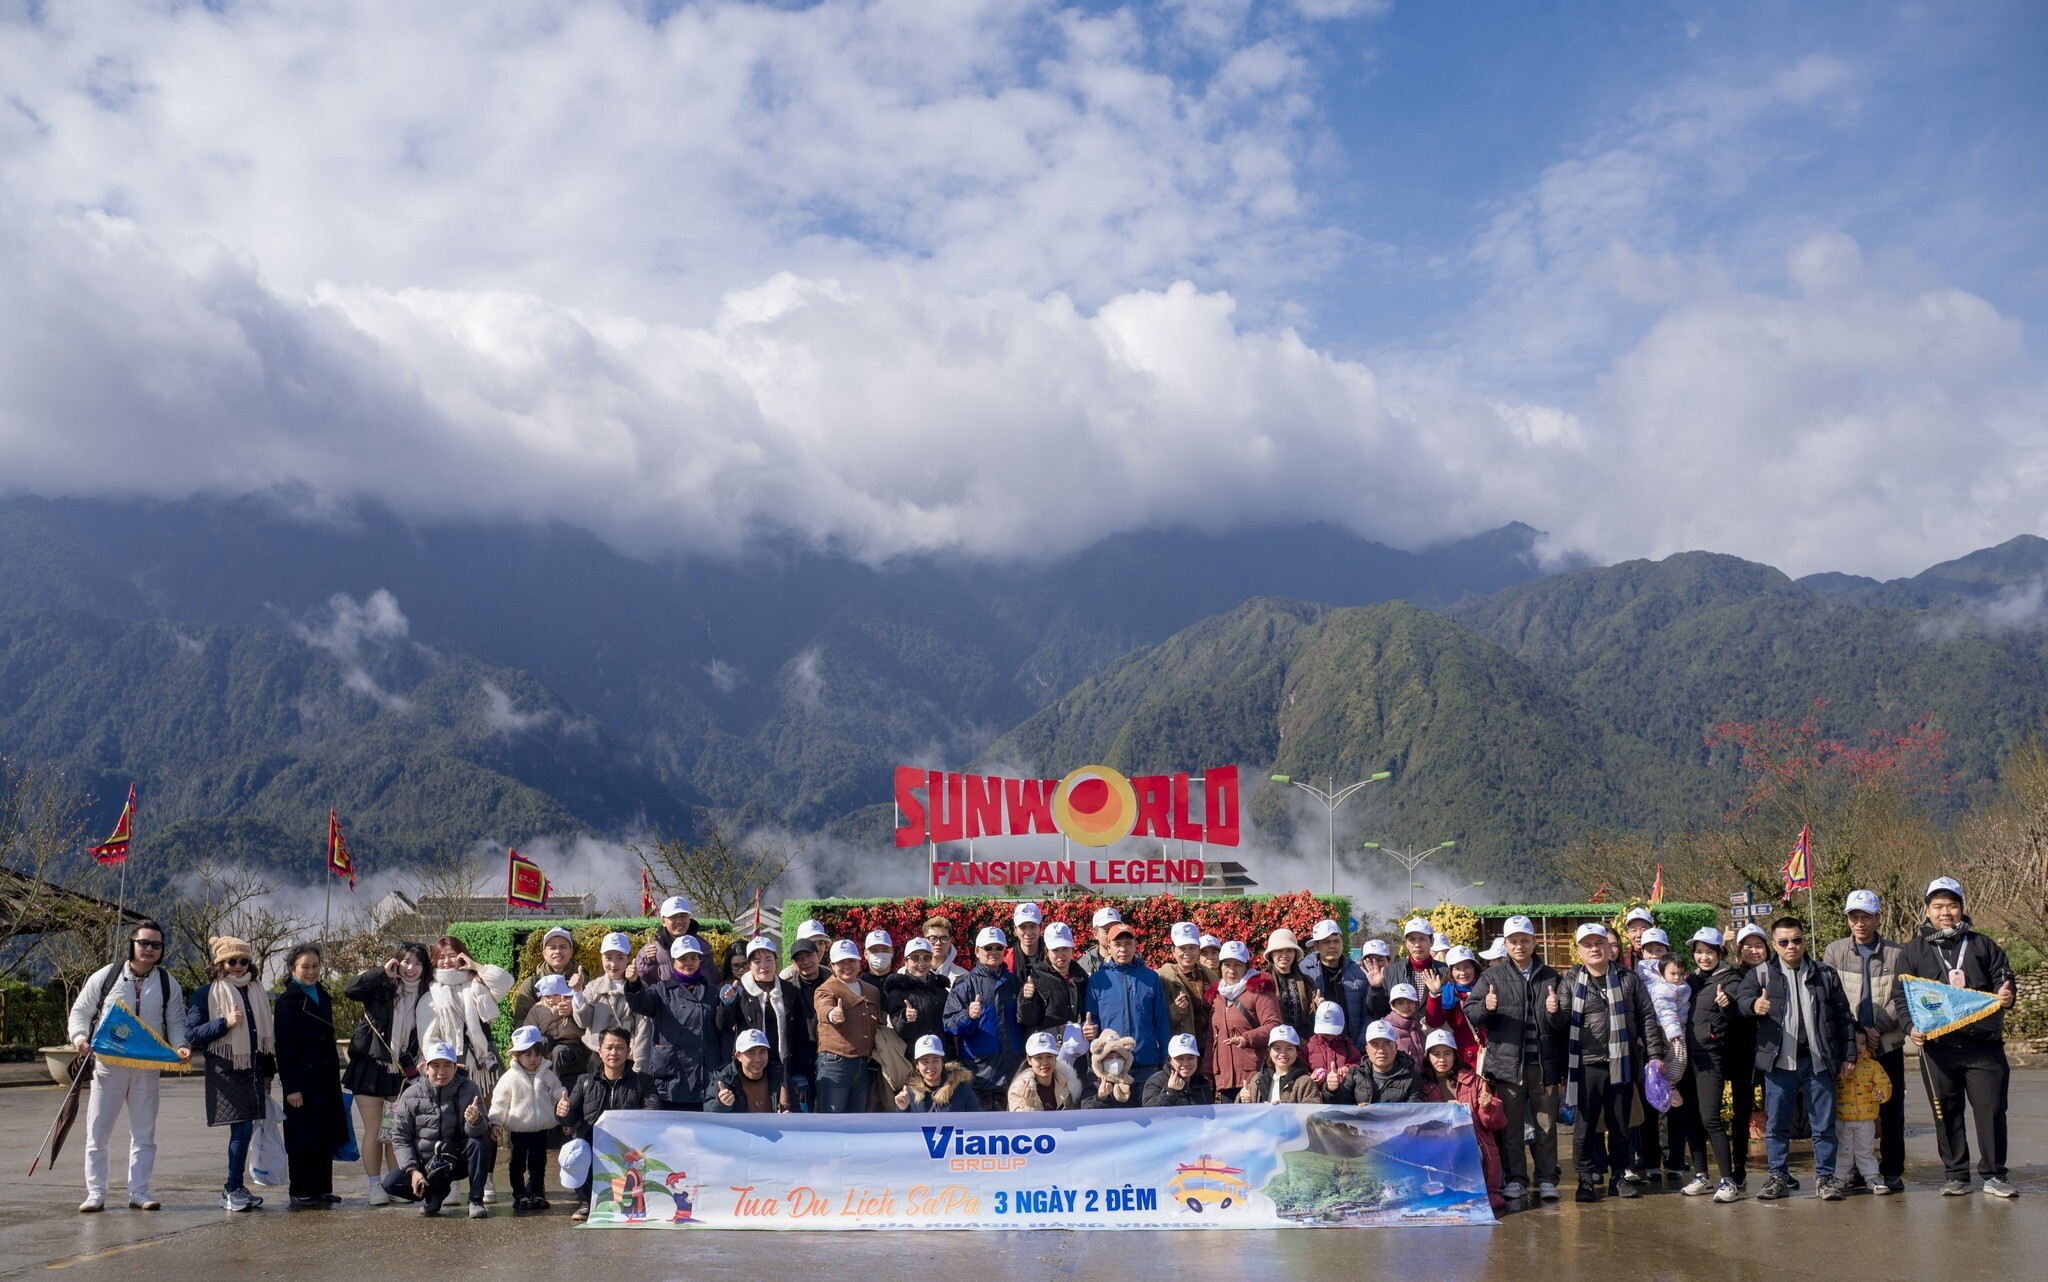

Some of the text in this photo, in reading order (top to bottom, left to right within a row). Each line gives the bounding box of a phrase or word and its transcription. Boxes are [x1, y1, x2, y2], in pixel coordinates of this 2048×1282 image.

[933, 859, 1204, 886] FANSIPAN LEGEND
[921, 1126, 1056, 1159] Vianco
[950, 1158, 1026, 1171] GROUP
[730, 1185, 779, 1217] Tua
[787, 1186, 830, 1218] Du
[840, 1186, 896, 1222] Lịch
[995, 1191, 1008, 1214] 3
[1016, 1185, 1077, 1214] NGÀY
[1085, 1190, 1099, 1212] 2
[1106, 1184, 1157, 1212] ĐÊM
